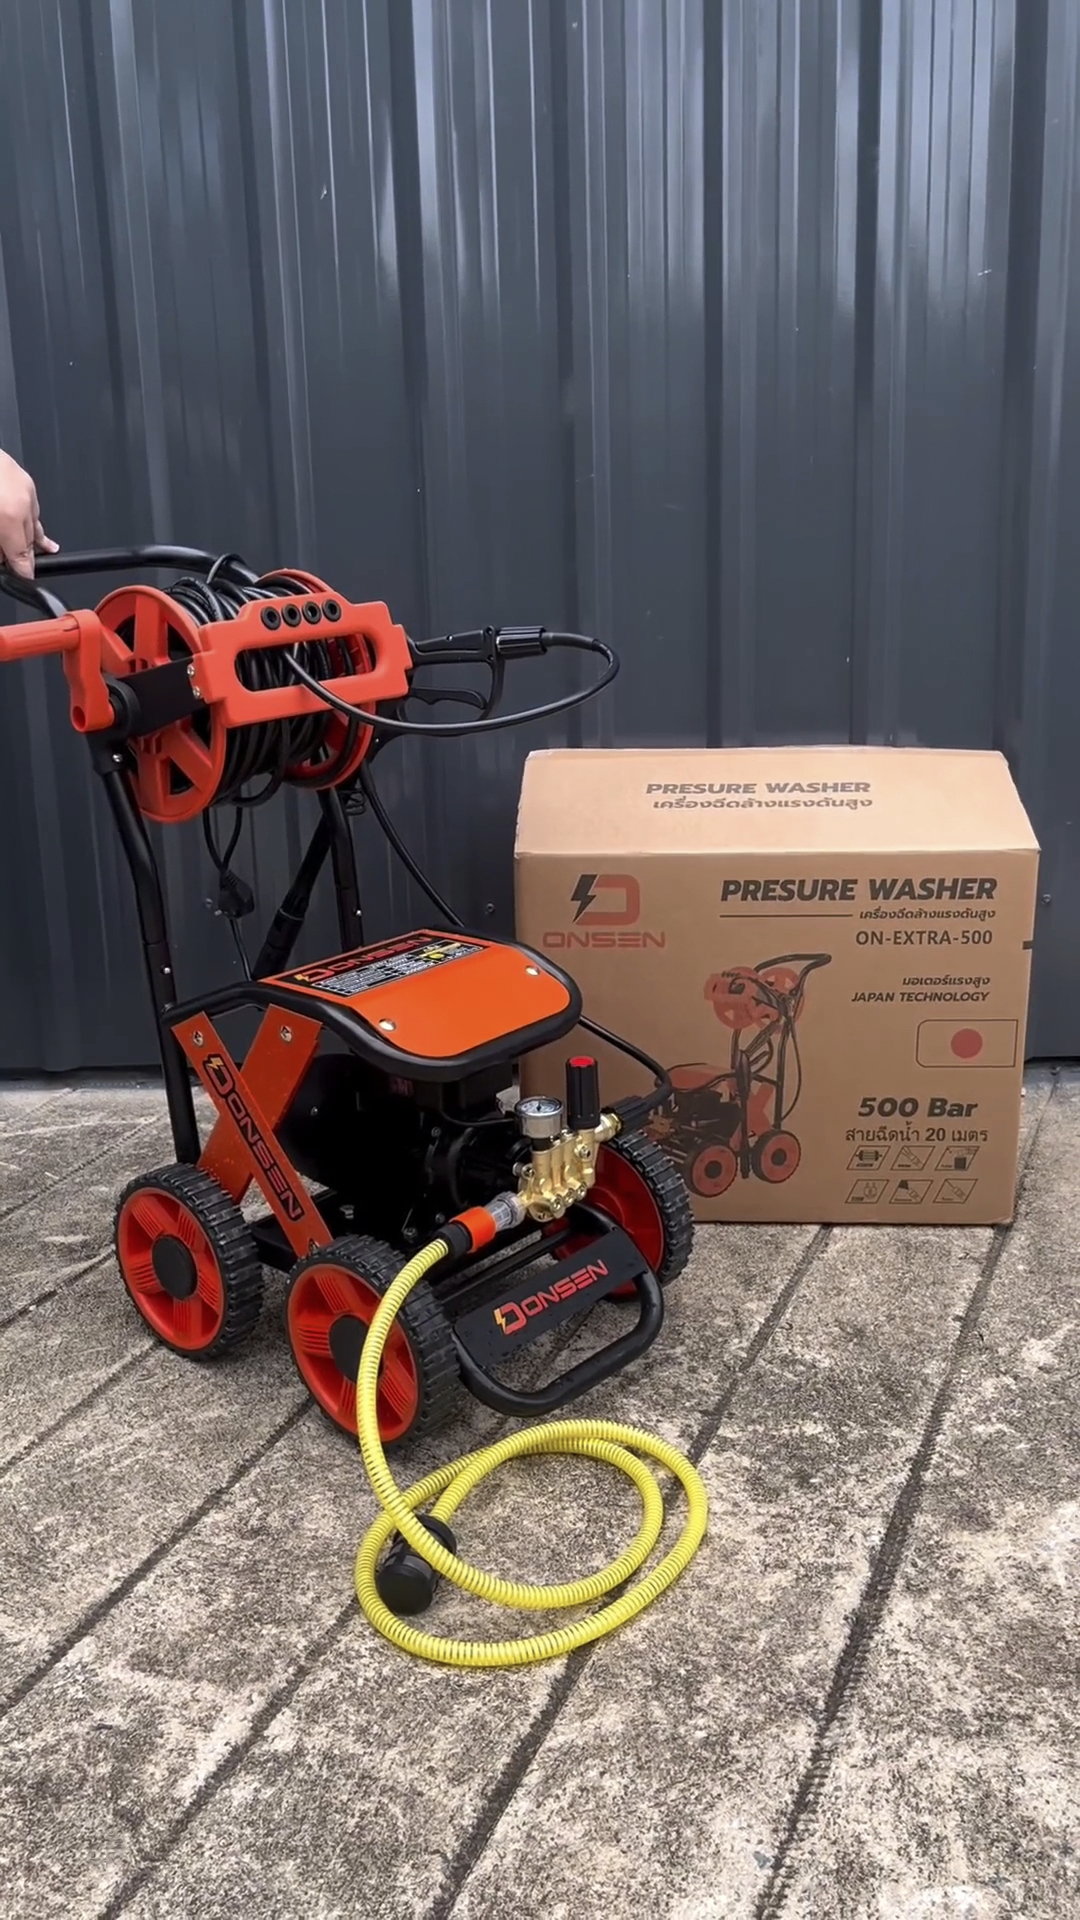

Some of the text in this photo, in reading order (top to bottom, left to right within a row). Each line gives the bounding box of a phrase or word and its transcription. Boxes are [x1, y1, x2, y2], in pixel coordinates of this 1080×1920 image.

[646, 782, 871, 794] PRESURE WASHER
[653, 796, 873, 810] เครื่องฉีดล้างแรงดันสูง
[720, 878, 998, 901] PRESURE WASHER
[859, 906, 996, 921] เครื่องฉีดล้างแรงดันสูง
[542, 931, 666, 948] ONSEN
[855, 930, 993, 945] ON-EXTRA-500
[902, 974, 991, 988] มอเตอร์แรงสูง
[851, 992, 990, 1002] JAPAN TECHNOLOGY
[858, 1097, 979, 1117] 500 Bar
[845, 1121, 989, 1142] สายฉีดน้ำ 20 เมตร
